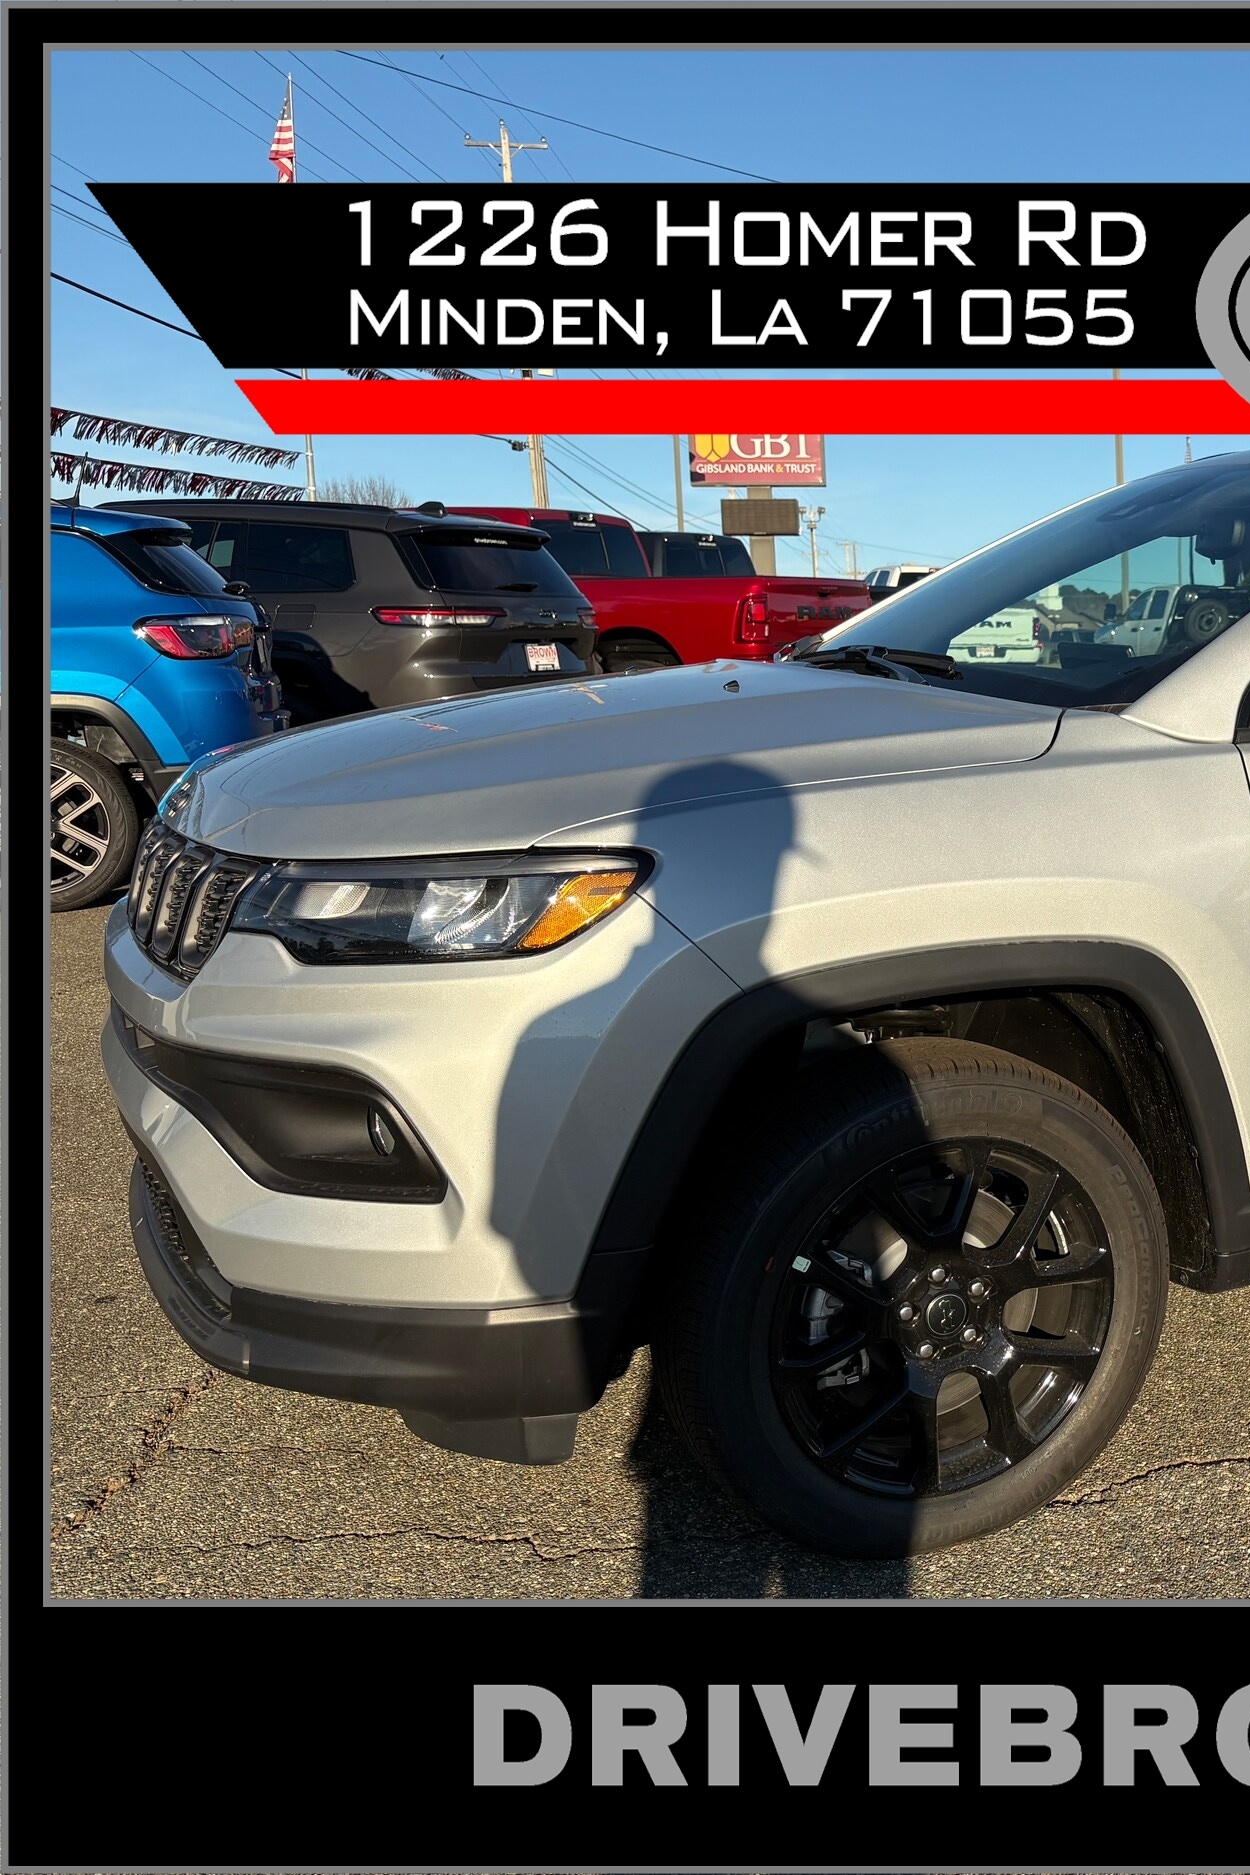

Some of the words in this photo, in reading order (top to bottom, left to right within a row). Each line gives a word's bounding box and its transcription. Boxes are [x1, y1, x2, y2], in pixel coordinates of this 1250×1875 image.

[696, 463, 746, 474] GIBSLAND
[747, 464, 774, 473] BANK
[775, 464, 784, 473] &
[784, 464, 817, 473] TRUST
[797, 605, 852, 620] RAM
[528, 646, 558, 659] BROWN
